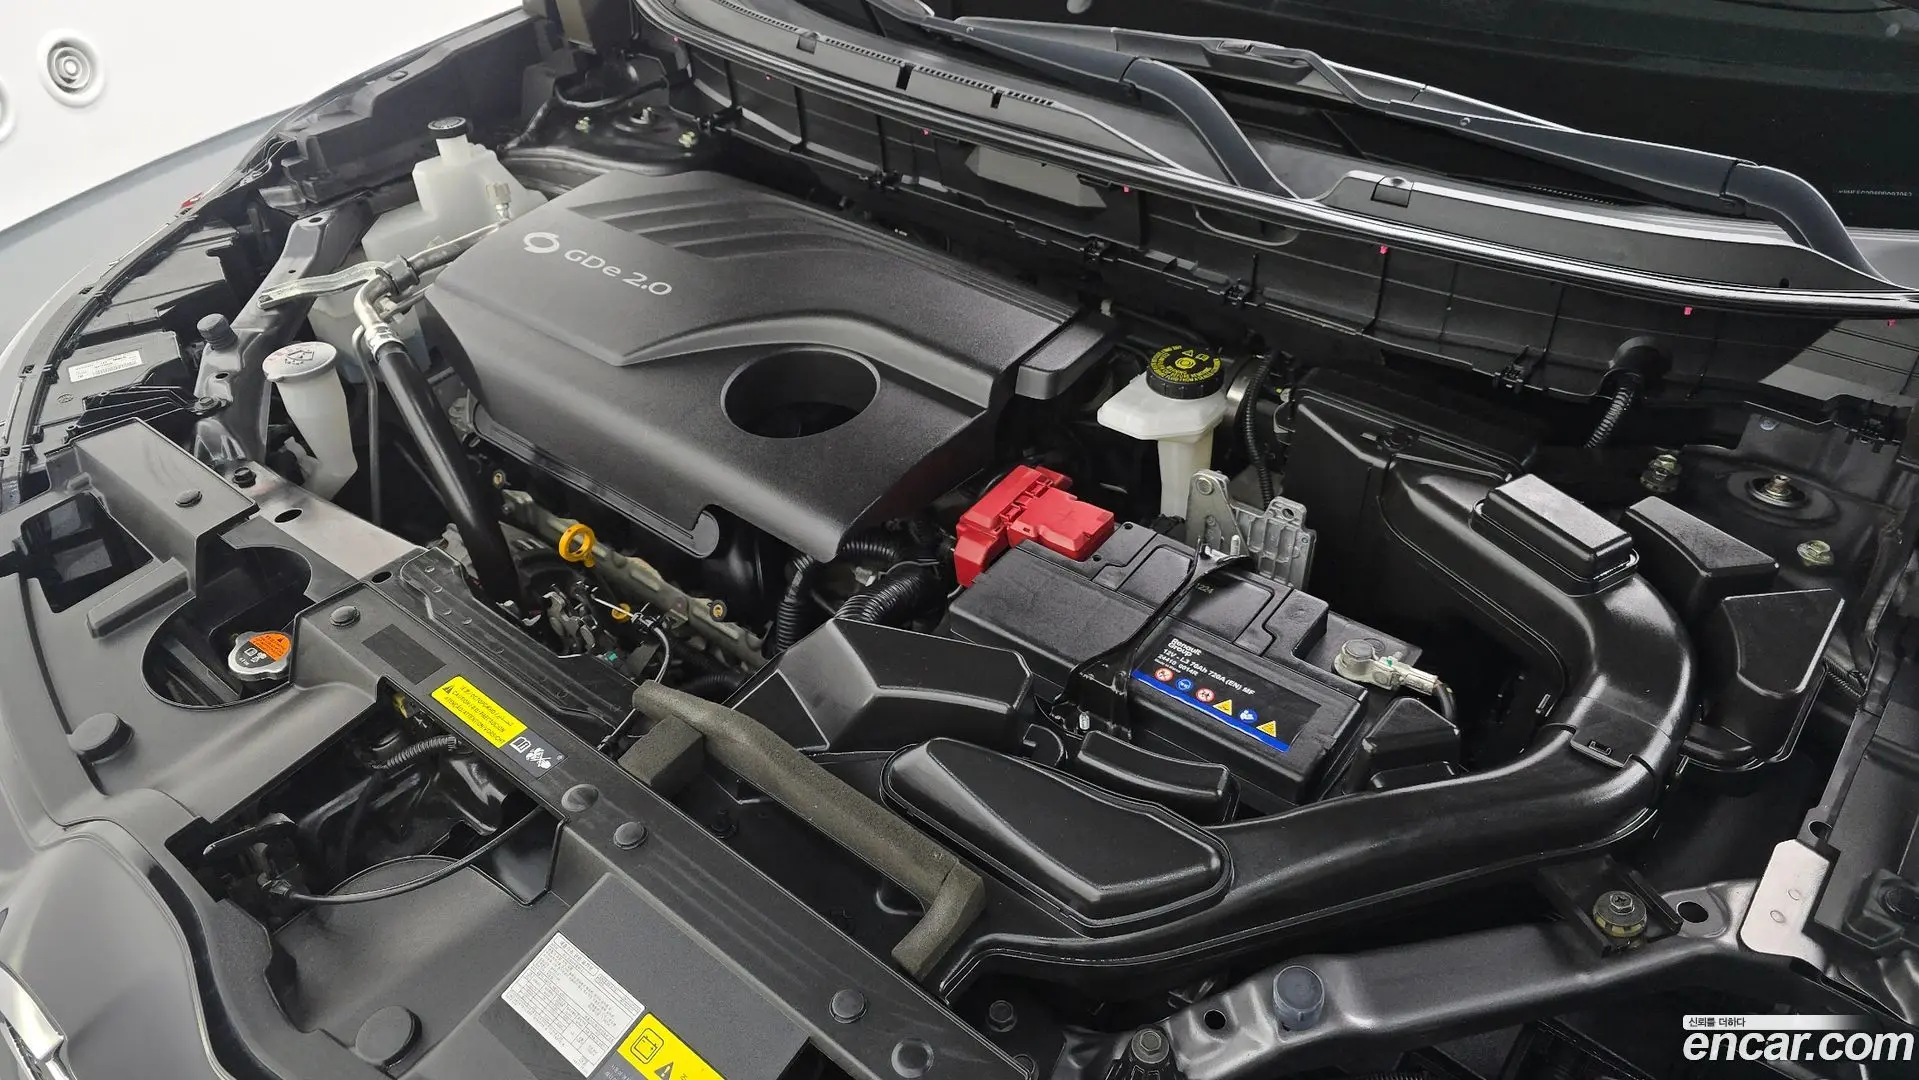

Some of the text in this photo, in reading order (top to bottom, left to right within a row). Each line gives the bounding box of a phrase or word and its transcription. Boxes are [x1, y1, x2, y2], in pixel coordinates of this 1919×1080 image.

[564, 249, 673, 295] GDe 2.0
[1167, 642, 1193, 657] Group
[1171, 638, 1202, 656] Renault
[1163, 648, 1176, 658] 12V
[1189, 660, 1208, 674] 70Ah
[1207, 669, 1226, 683] 720A
[1225, 677, 1243, 691] (EN)
[1242, 687, 1256, 696] MF
